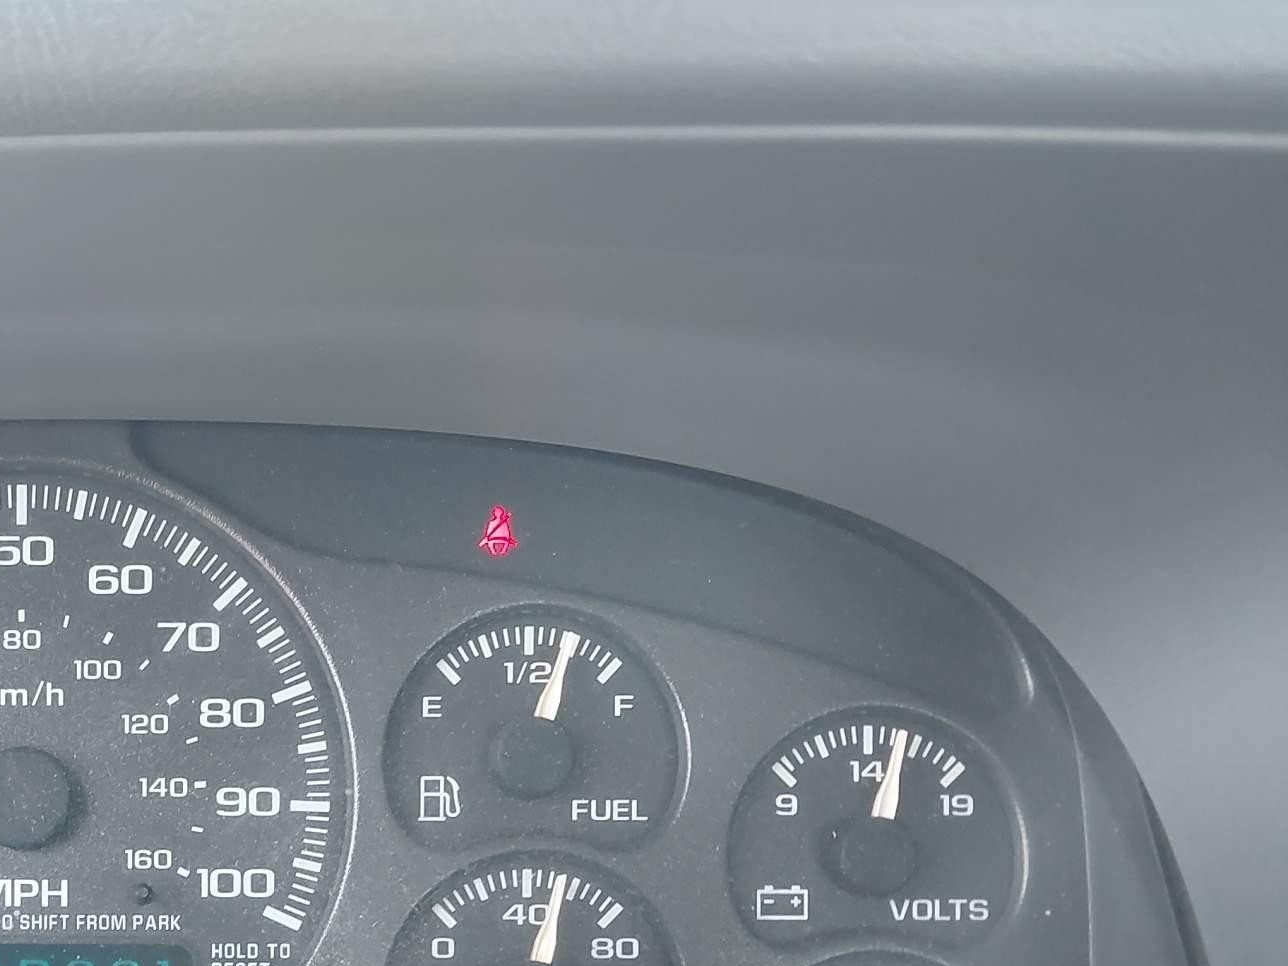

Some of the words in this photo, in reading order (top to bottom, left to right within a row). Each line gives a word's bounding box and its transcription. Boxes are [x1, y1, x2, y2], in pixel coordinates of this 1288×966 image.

[88, 565, 153, 595] 60
[2, 630, 42, 650] 80
[156, 622, 221, 652] 70
[74, 659, 122, 680] 100
[503, 661, 553, 684] 1/2
[199, 699, 265, 728] 80
[422, 696, 442, 717] E
[613, 695, 634, 716] F
[121, 714, 170, 735] 120
[849, 760, 884, 782] 14
[138, 778, 188, 798] 140
[215, 787, 281, 817] 90
[571, 799, 648, 821] FUEL
[775, 794, 799, 816] 9
[939, 794, 974, 816] 19
[124, 850, 173, 870] 160
[197, 869, 276, 898] 100
[502, 903, 548, 926] 40
[889, 899, 990, 921] VOLTS
[19, 914, 68, 930] SHIFT
[75, 914, 126, 930] FROM
[132, 914, 181, 930] PARK
[212, 944, 258, 959] HOLD
[266, 944, 290, 959] TO
[431, 938, 455, 958] 0
[590, 938, 640, 959] 80
